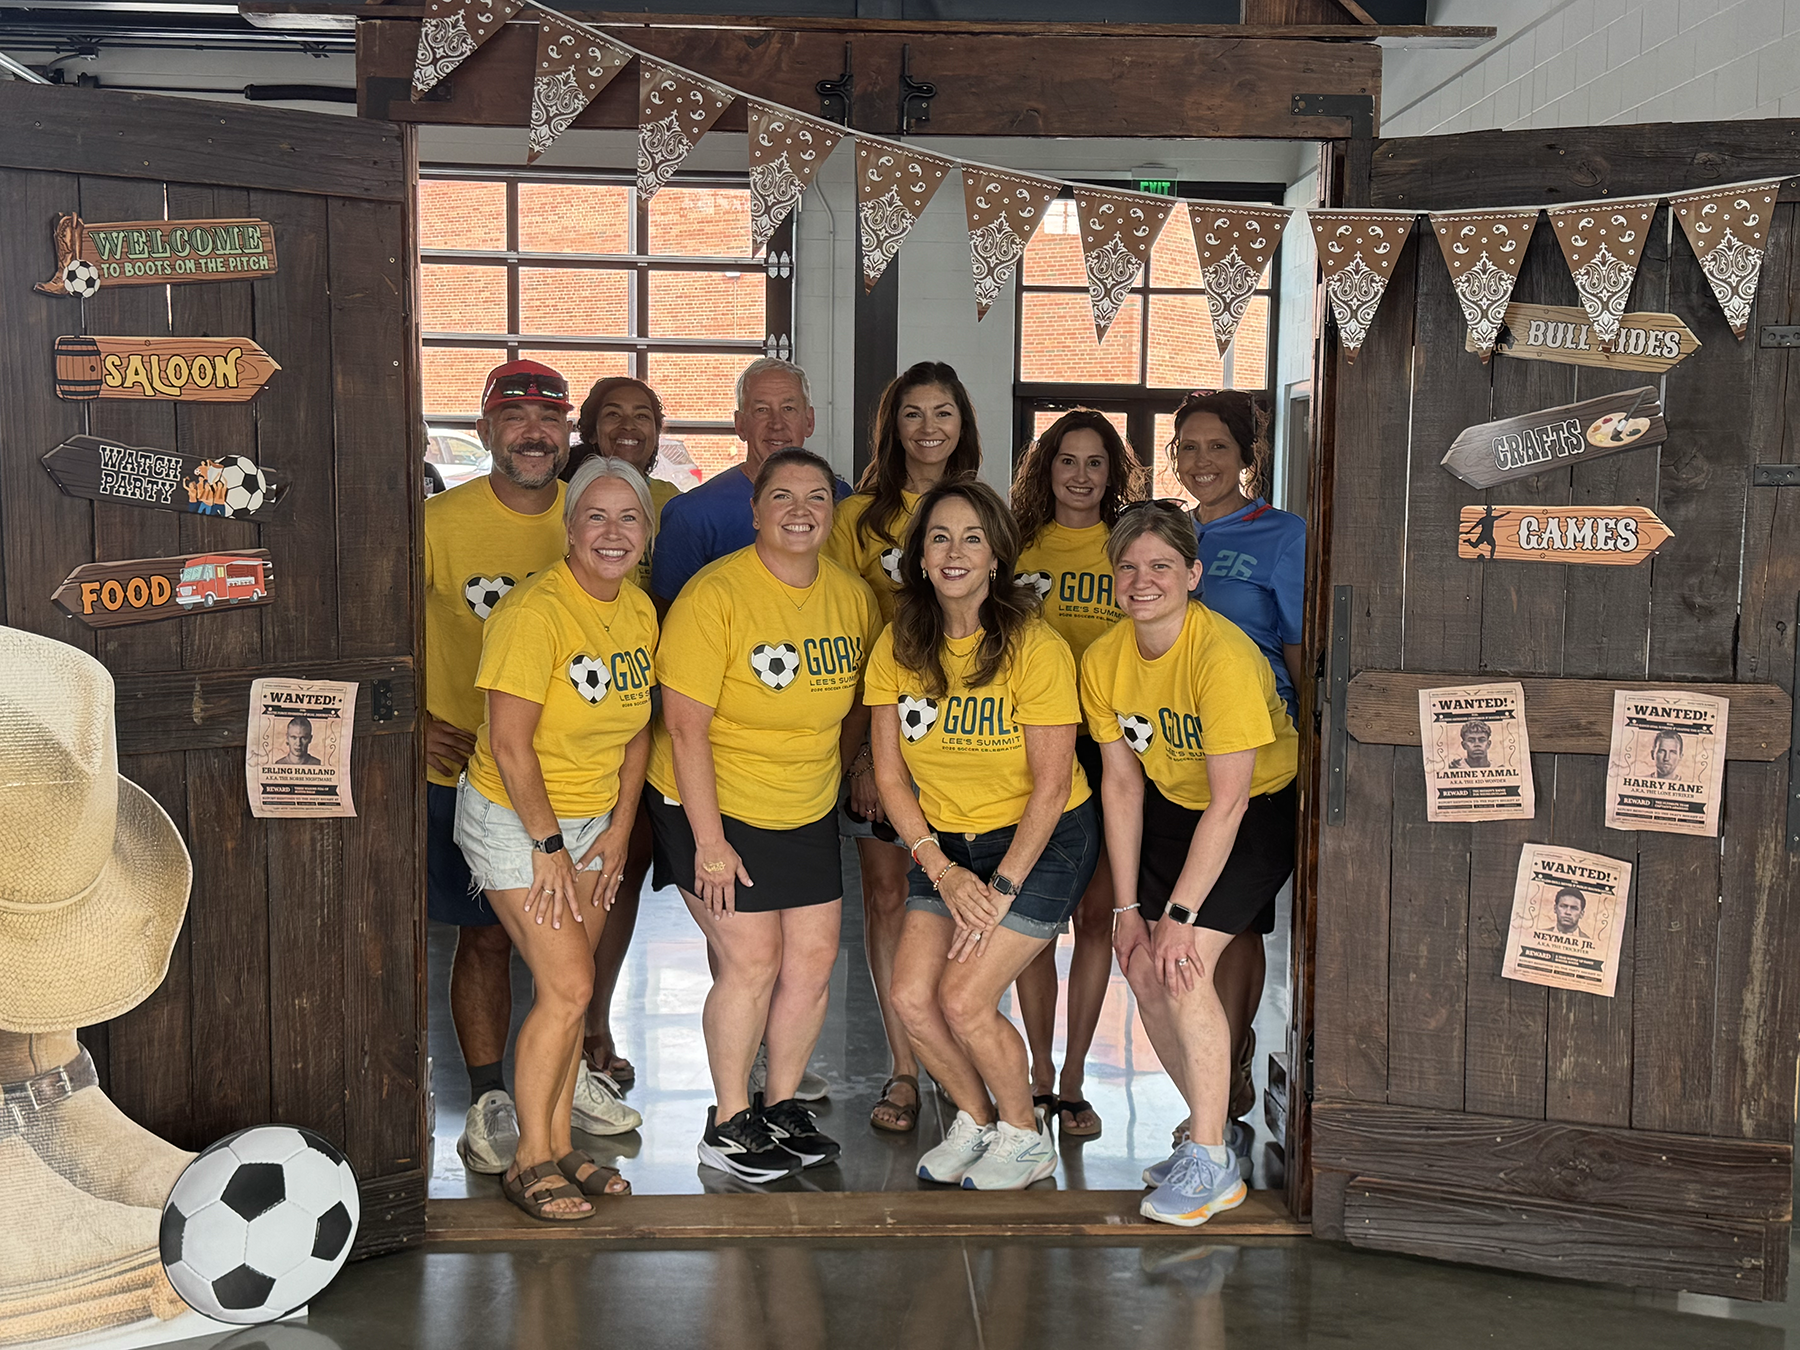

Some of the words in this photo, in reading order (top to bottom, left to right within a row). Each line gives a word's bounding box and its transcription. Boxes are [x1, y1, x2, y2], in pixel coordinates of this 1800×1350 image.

[1140, 181, 1170, 195] EXIT
[88, 225, 263, 260] WELCOME
[101, 263, 120, 278] TO
[124, 260, 172, 277] BOOTS
[175, 259, 196, 274] ON
[199, 257, 226, 272] THE
[229, 255, 269, 271] PITCH
[1527, 320, 1590, 350] BULL
[1598, 327, 1681, 359] IDES
[104, 348, 243, 396] SALOON
[1492, 418, 1585, 471] CRAFTS
[99, 445, 182, 481] WATCH
[100, 470, 176, 504] PARTY
[1517, 516, 1639, 552] GAMES
[1207, 549, 1258, 581] 26
[80, 575, 172, 615] FOOD
[1059, 571, 1121, 609] GOA
[610, 645, 651, 692] GOA
[810, 678, 836, 686] LEE'S
[270, 691, 336, 706] WANTED!
[1438, 698, 1508, 710] WANTED!
[1633, 704, 1708, 721] WANTED!
[941, 737, 973, 746] LEE'S
[976, 735, 1021, 747] SUMMIT
[262, 767, 293, 775] ERLING
[294, 768, 336, 776] HAALAND
[1436, 771, 1478, 779] LAMINE
[1480, 769, 1519, 778] YAMAL
[1623, 777, 1666, 790] HARRY
[1668, 782, 1703, 794] KANE
[1623, 797, 1651, 806] REWARD
[1541, 860, 1611, 882] WANTED!
[1533, 931, 1579, 947] NEYMAR
[1580, 940, 1596, 950] JR.
[1525, 949, 1552, 959] REWARD
